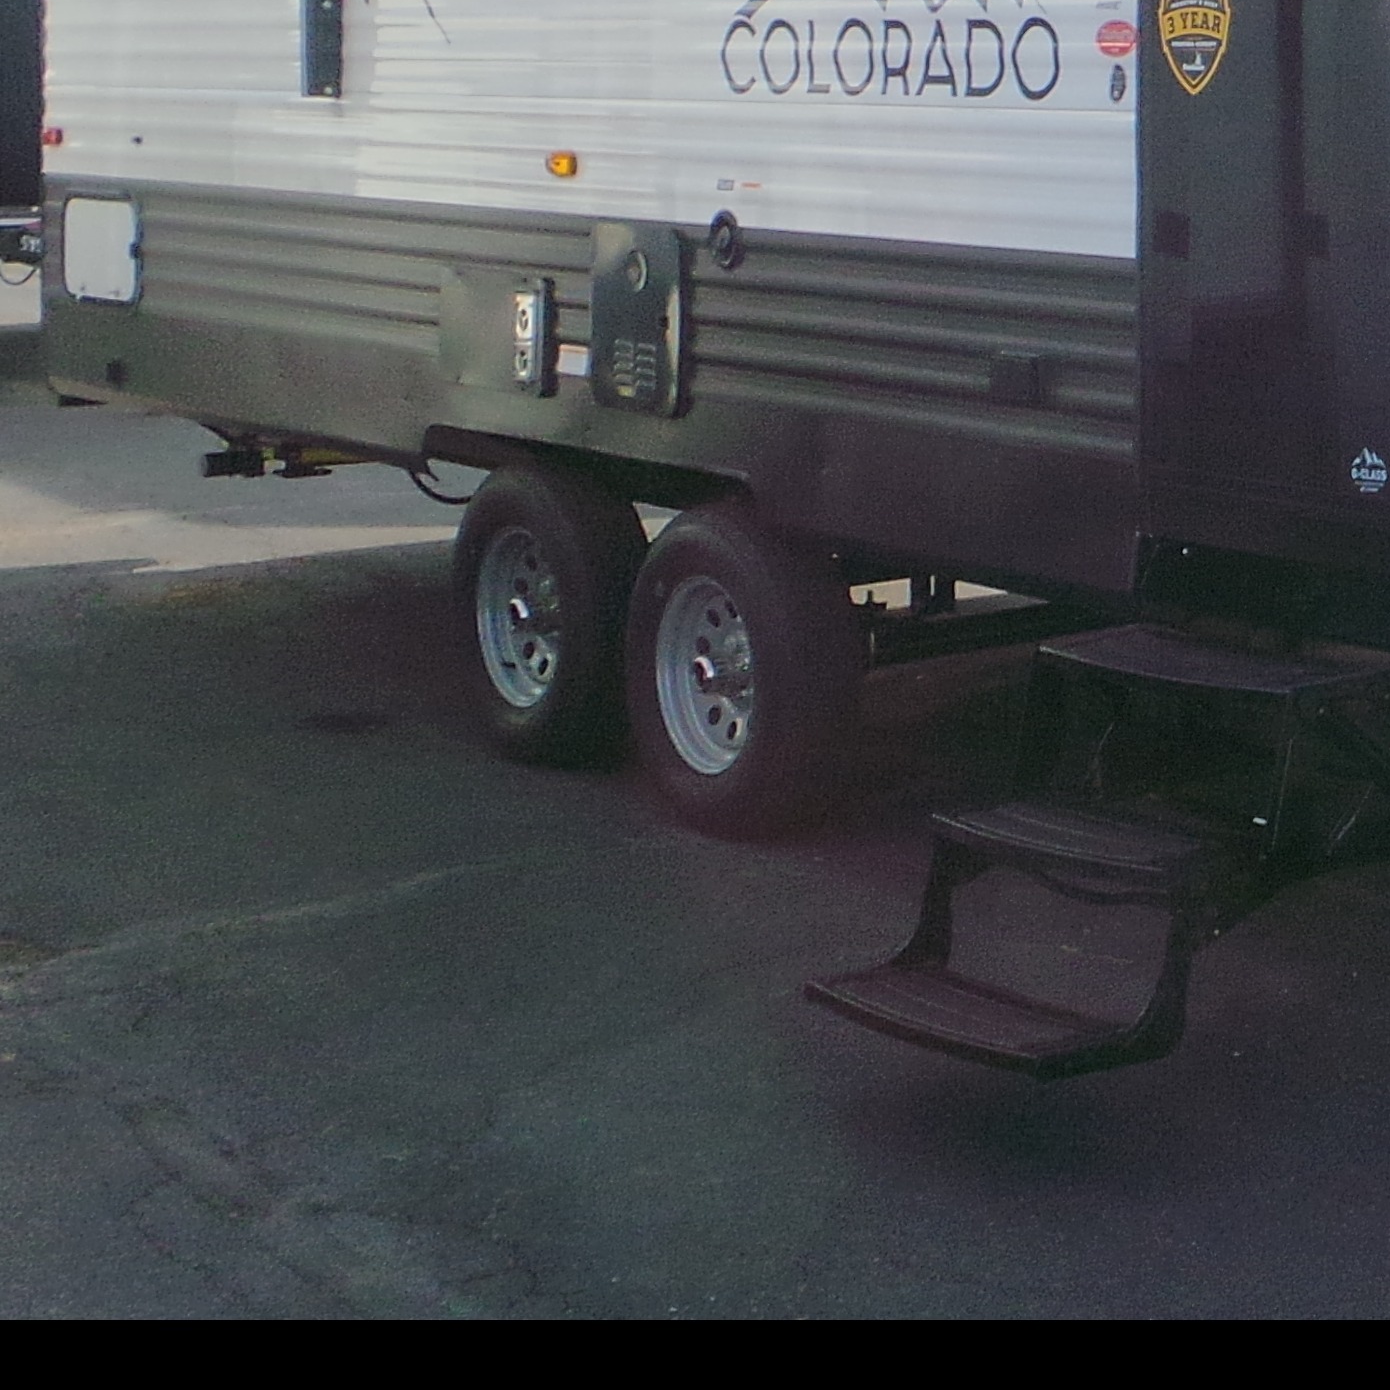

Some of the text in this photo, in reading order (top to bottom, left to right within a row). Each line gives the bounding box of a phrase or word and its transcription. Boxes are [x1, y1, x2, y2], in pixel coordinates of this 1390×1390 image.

[1167, 12, 1221, 34] 3 YEAR
[721, 17, 1060, 101] COLORADO
